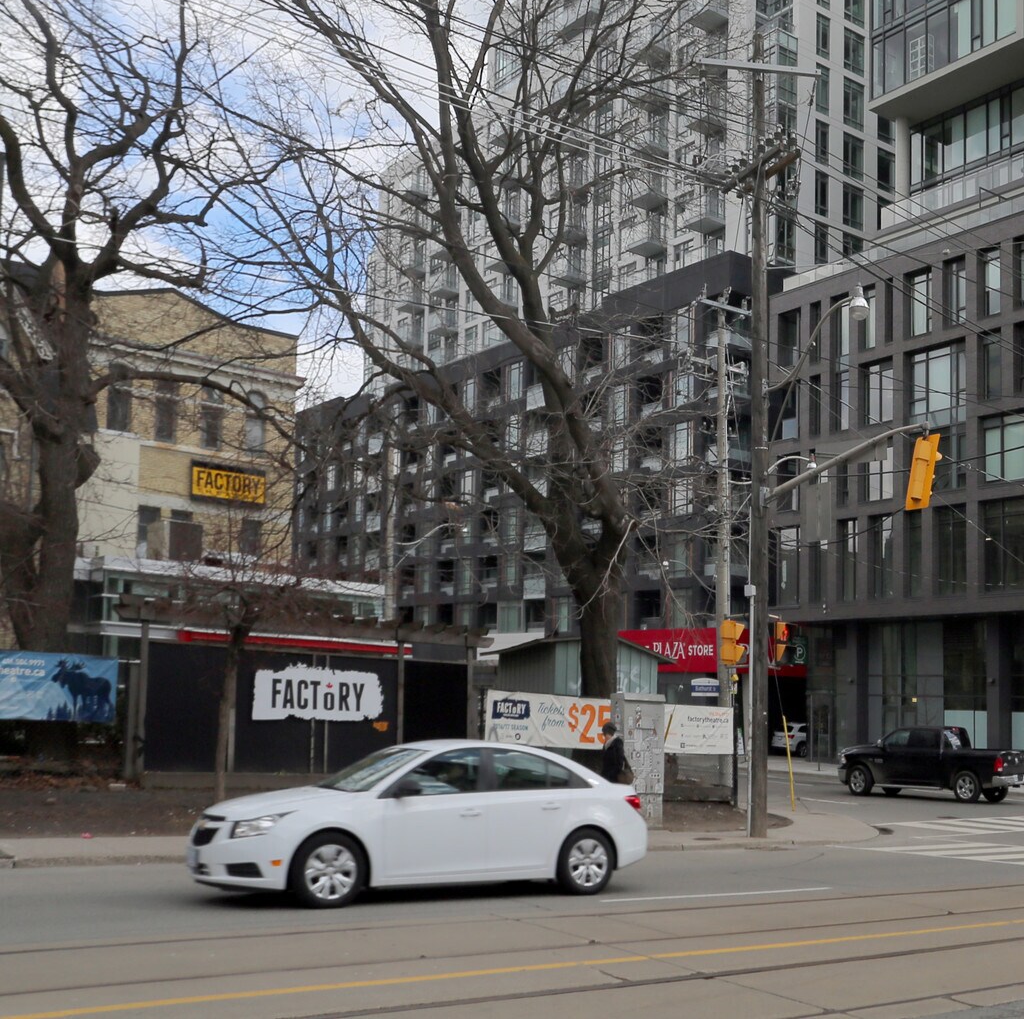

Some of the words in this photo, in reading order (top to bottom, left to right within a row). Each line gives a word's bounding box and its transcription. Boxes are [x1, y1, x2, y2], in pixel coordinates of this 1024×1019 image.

[196, 470, 261, 495] FACTORY
[688, 645, 714, 656] STORE
[271, 678, 365, 712] FACTORY
[496, 702, 527, 715] FACTORY
[537, 702, 565, 716] Tickets
[541, 716, 565, 732] from
[568, 703, 612, 744] $25
